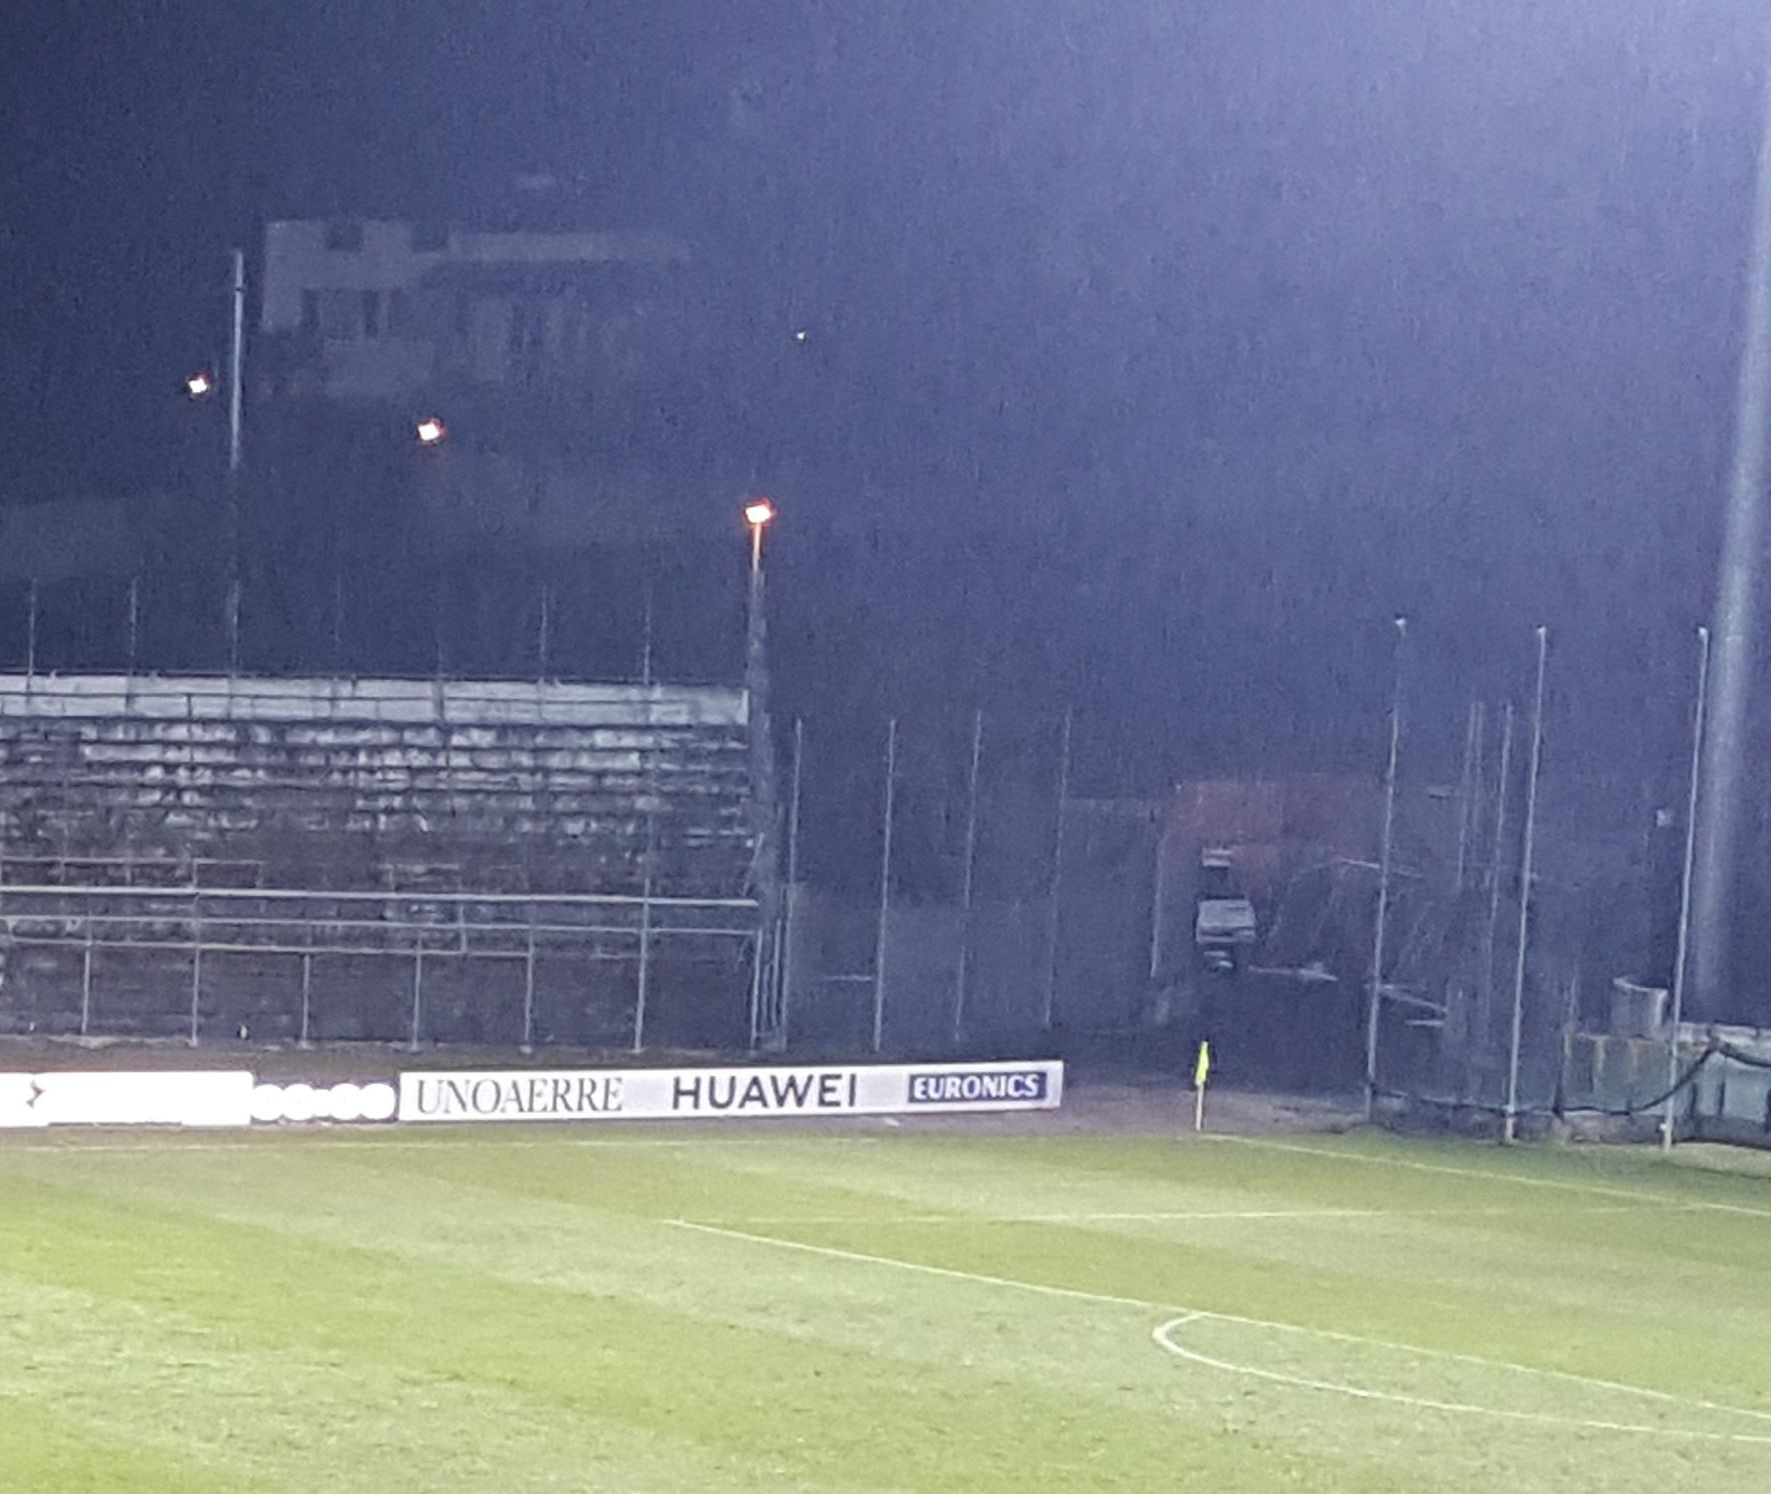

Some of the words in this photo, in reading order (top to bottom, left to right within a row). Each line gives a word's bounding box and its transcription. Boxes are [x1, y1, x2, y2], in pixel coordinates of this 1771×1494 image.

[417, 1077, 623, 1115] UNOAERRE
[671, 1074, 857, 1110] HUAWEI
[913, 1074, 1041, 1099] EURONICS
